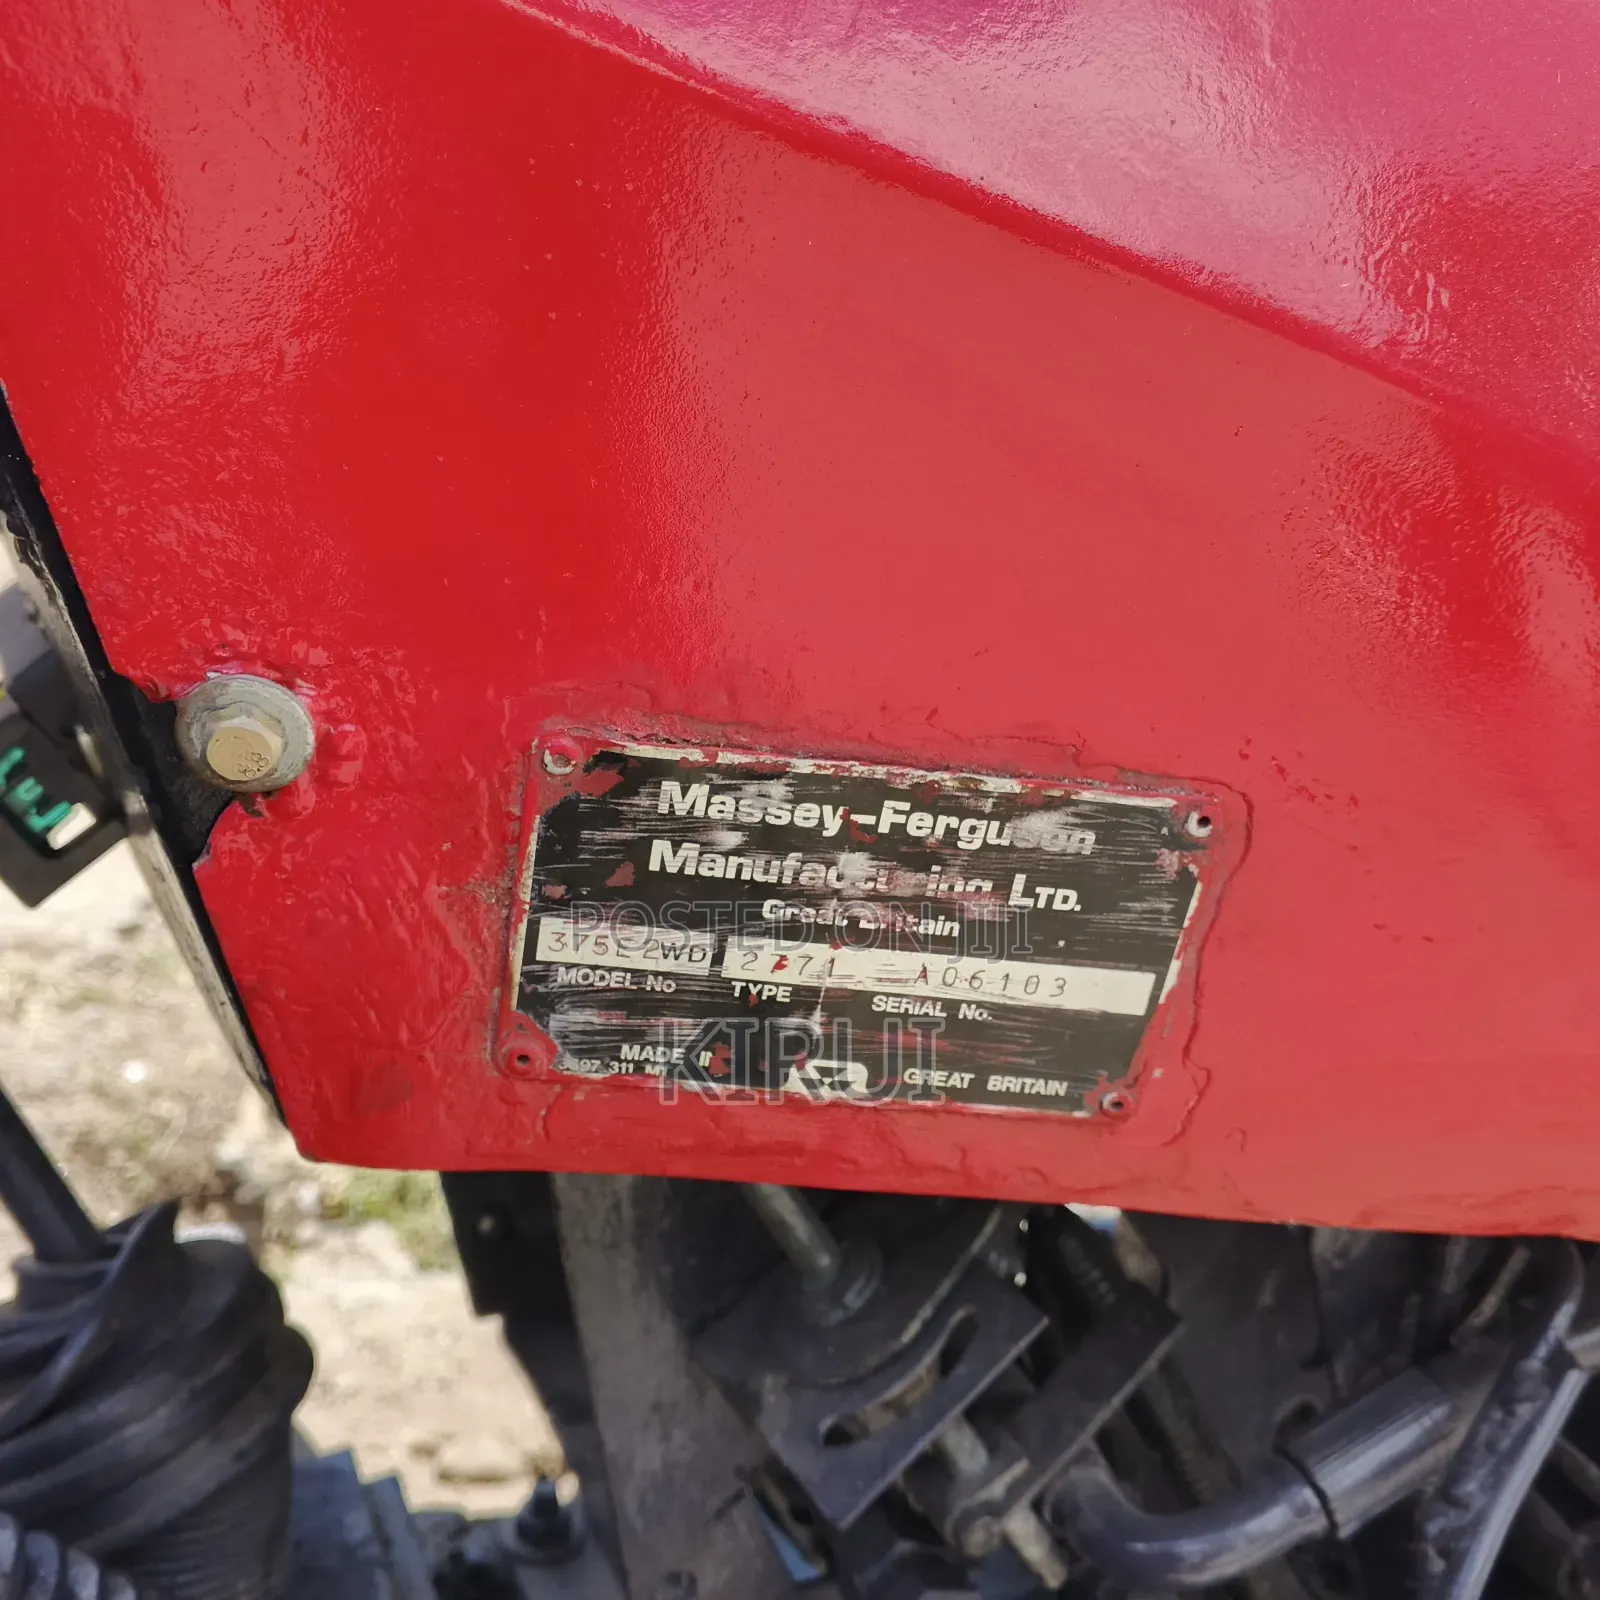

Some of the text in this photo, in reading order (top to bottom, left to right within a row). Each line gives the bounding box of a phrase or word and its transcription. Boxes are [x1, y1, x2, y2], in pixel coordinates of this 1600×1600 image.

[648, 839, 1083, 912] Manufacuing LTD.
[556, 966, 637, 990] MODEL
[731, 981, 793, 1003] TYPE
[871, 995, 994, 1022] SERIAL No.
[620, 1044, 687, 1065] MADE
[903, 1067, 975, 1090] GREAT
[987, 1075, 1069, 1097] BRITAIN
